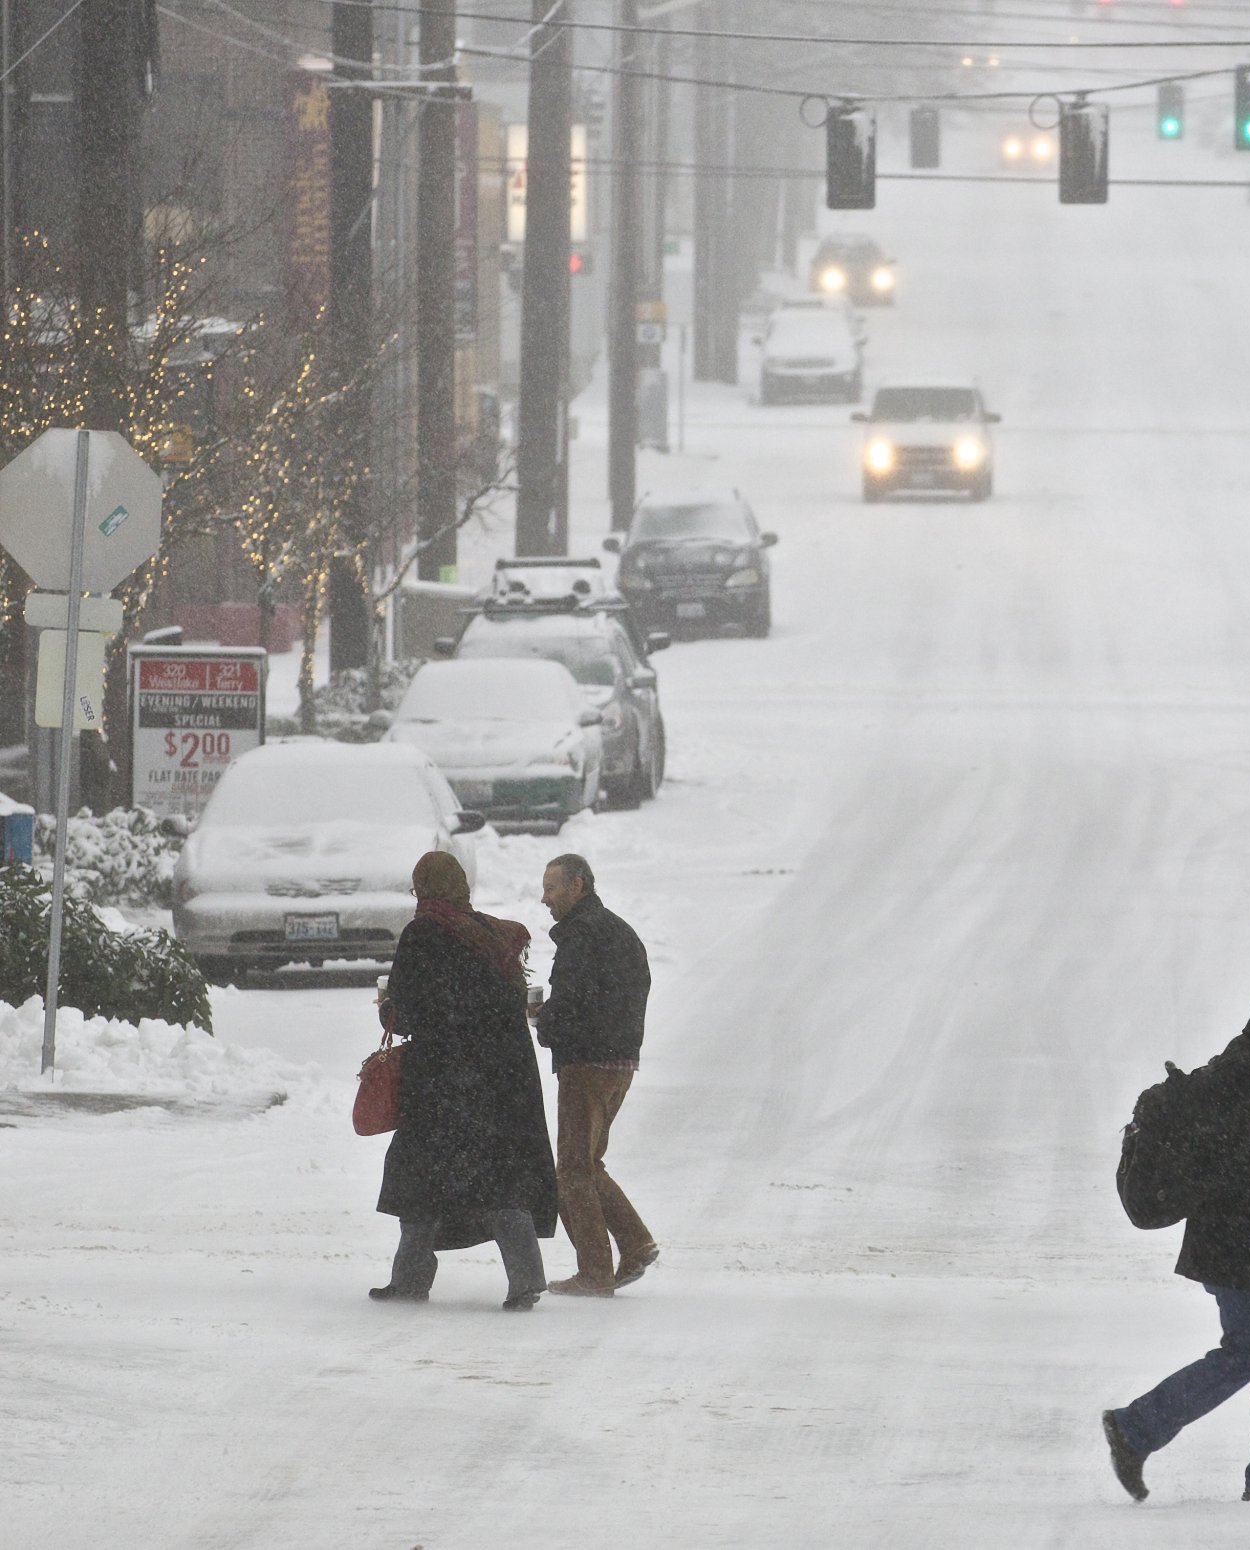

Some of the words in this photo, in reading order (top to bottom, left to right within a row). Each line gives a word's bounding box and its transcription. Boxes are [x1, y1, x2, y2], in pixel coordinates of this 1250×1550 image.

[163, 664, 186, 677] 320
[219, 665, 241, 678] 321
[149, 675, 200, 689] Westlake
[216, 677, 244, 691] Terry
[174, 715, 222, 727] SPECIAL
[148, 769, 171, 783] FLAT
[174, 769, 200, 783] RATE
[201, 769, 222, 784] PAR
